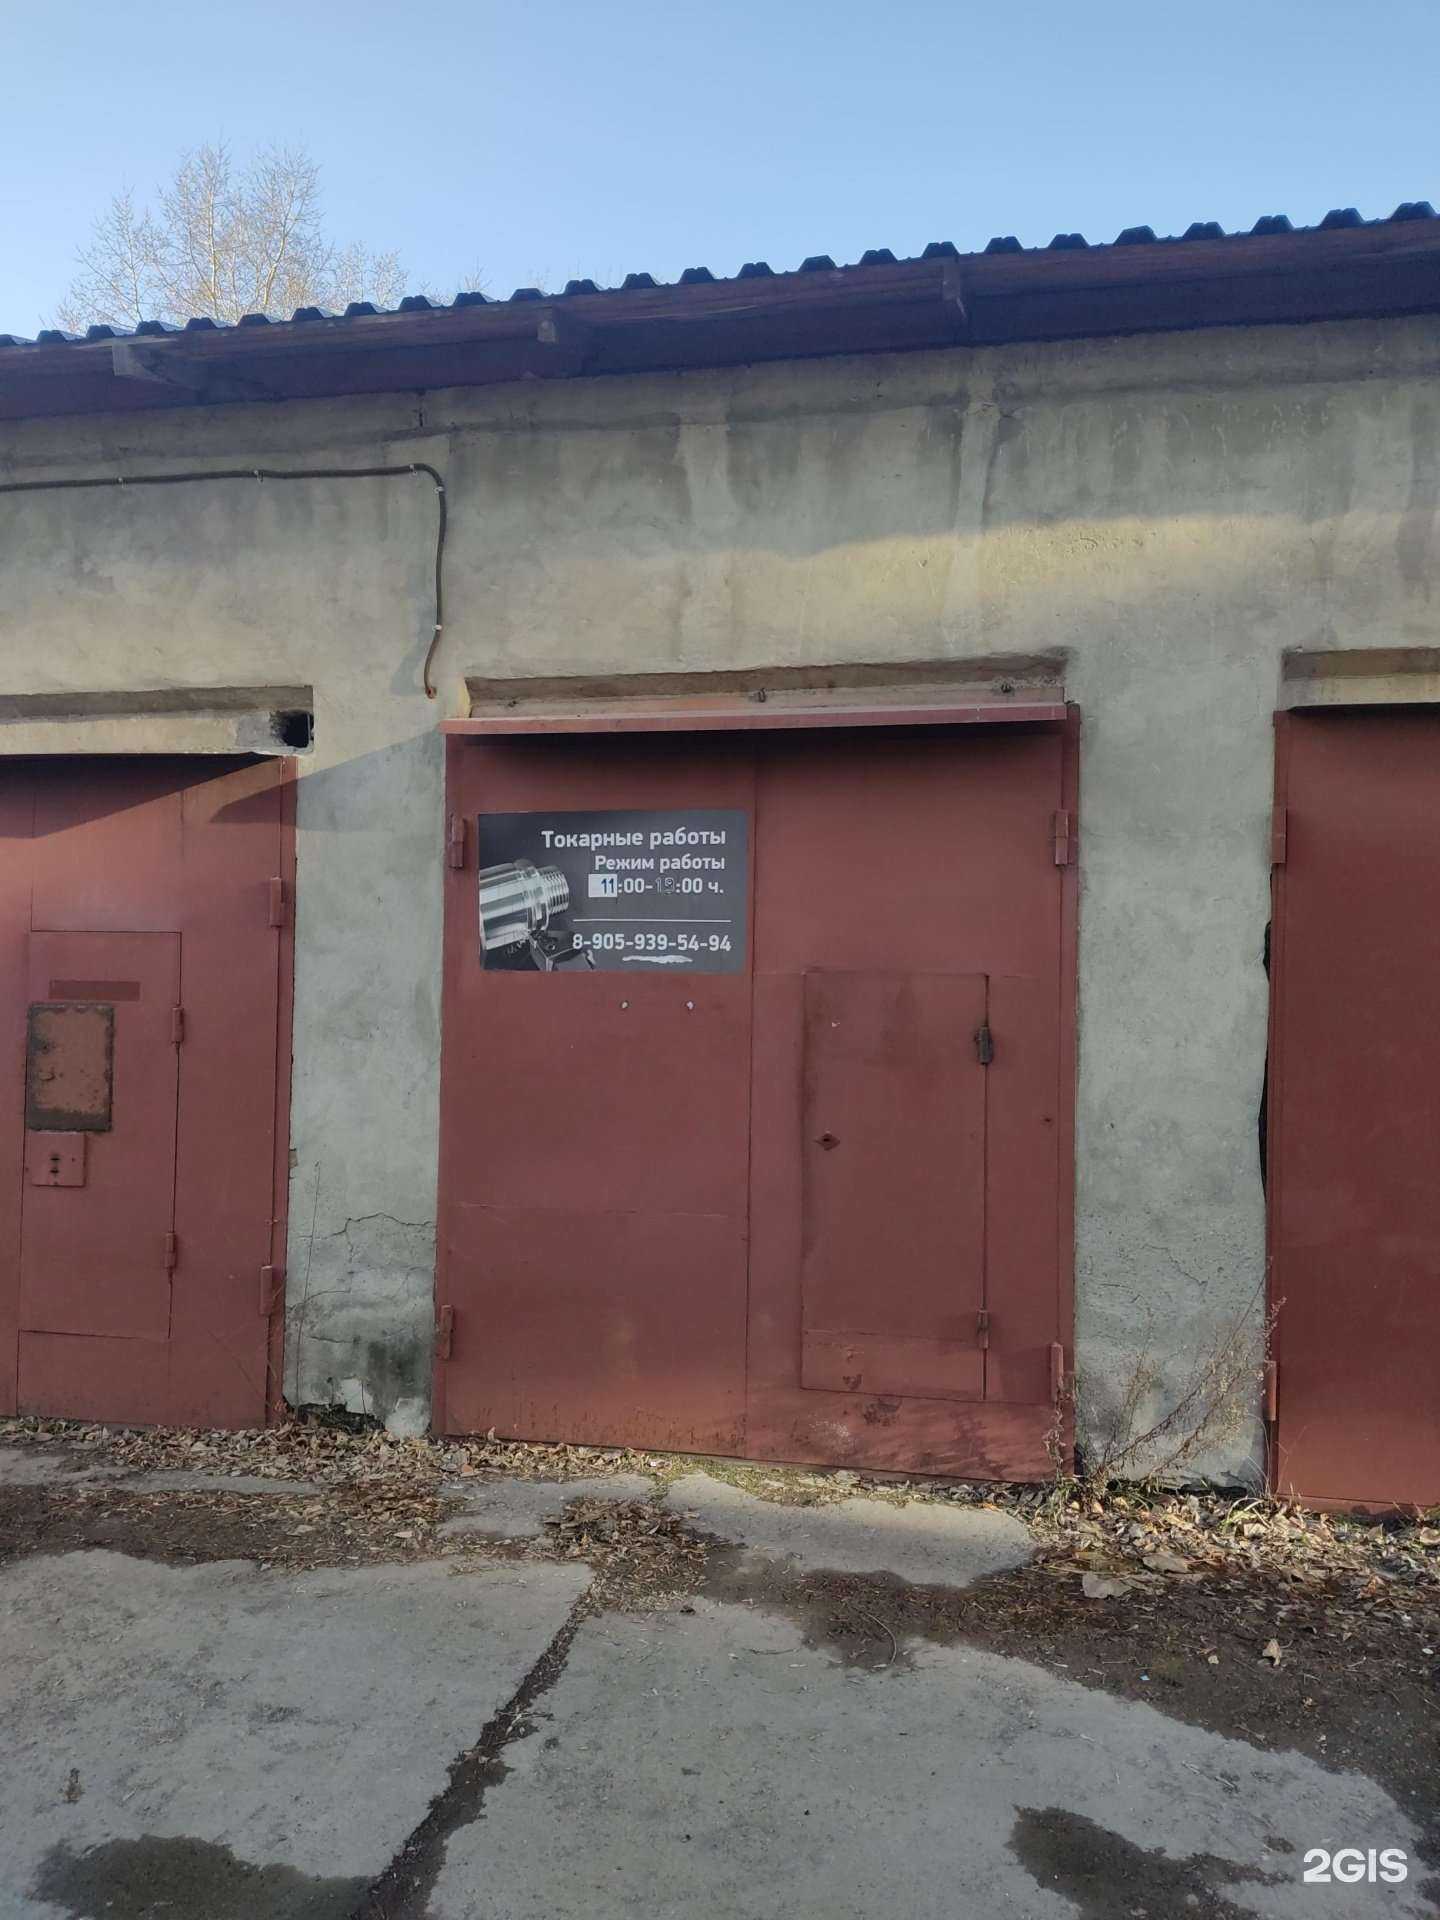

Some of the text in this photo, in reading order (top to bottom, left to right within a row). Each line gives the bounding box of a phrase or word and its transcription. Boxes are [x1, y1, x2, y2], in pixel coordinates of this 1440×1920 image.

[541, 827, 726, 851] Токарные работы
[594, 854, 726, 873] Режим работы
[572, 933, 732, 951] 8-905-939-54-94
